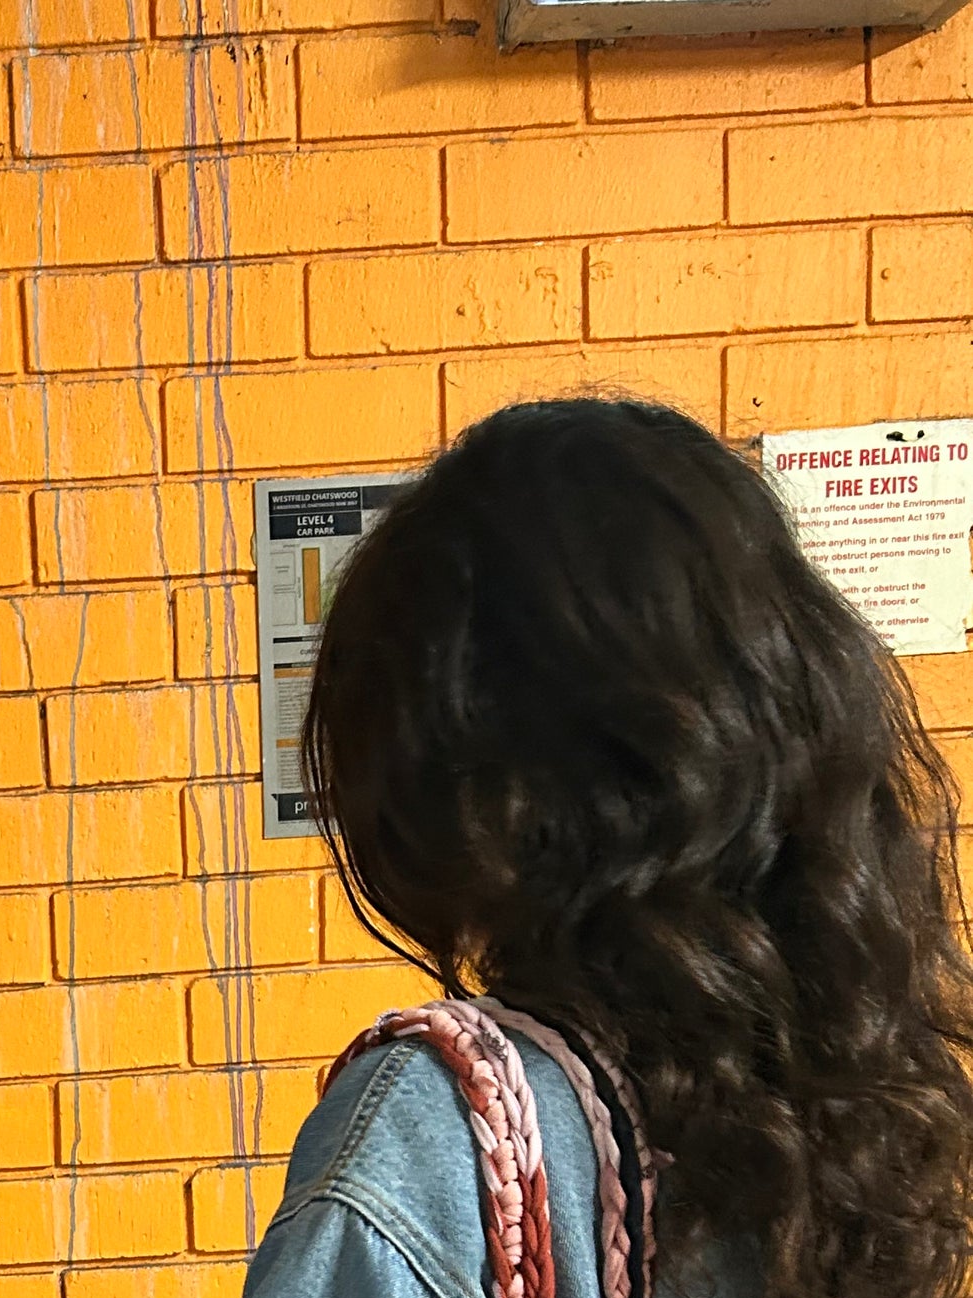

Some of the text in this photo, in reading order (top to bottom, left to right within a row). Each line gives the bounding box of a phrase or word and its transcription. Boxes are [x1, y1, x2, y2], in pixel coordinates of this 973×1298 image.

[777, 443, 968, 471] OFFENCE RELATING TO
[825, 476, 918, 498] FIRE EXITS
[272, 491, 358, 503] WESTFIELD CHATSWOOD
[811, 506, 821, 514] an
[824, 504, 856, 513] offence
[859, 502, 884, 511] under
[887, 500, 900, 509] the
[903, 497, 965, 508] Environmental
[297, 514, 334, 526] LEVEL 4
[796, 511, 945, 528] lanning and Assessment Act 1979
[296, 527, 335, 536] CAR PARK
[803, 539, 826, 549] place
[829, 537, 867, 549] anything
[869, 536, 877, 545] in
[891, 535, 911, 543] near
[913, 533, 930, 542] this
[932, 532, 947, 541] fire
[948, 531, 965, 540] exit
[831, 552, 868, 561] obstruct
[870, 550, 905, 560] persons
[908, 547, 940, 557] moving
[942, 546, 952, 554] to
[833, 567, 847, 575] the
[873, 583, 909, 592] obstruct
[912, 582, 926, 590] the
[887, 616, 929, 626] otherwise
